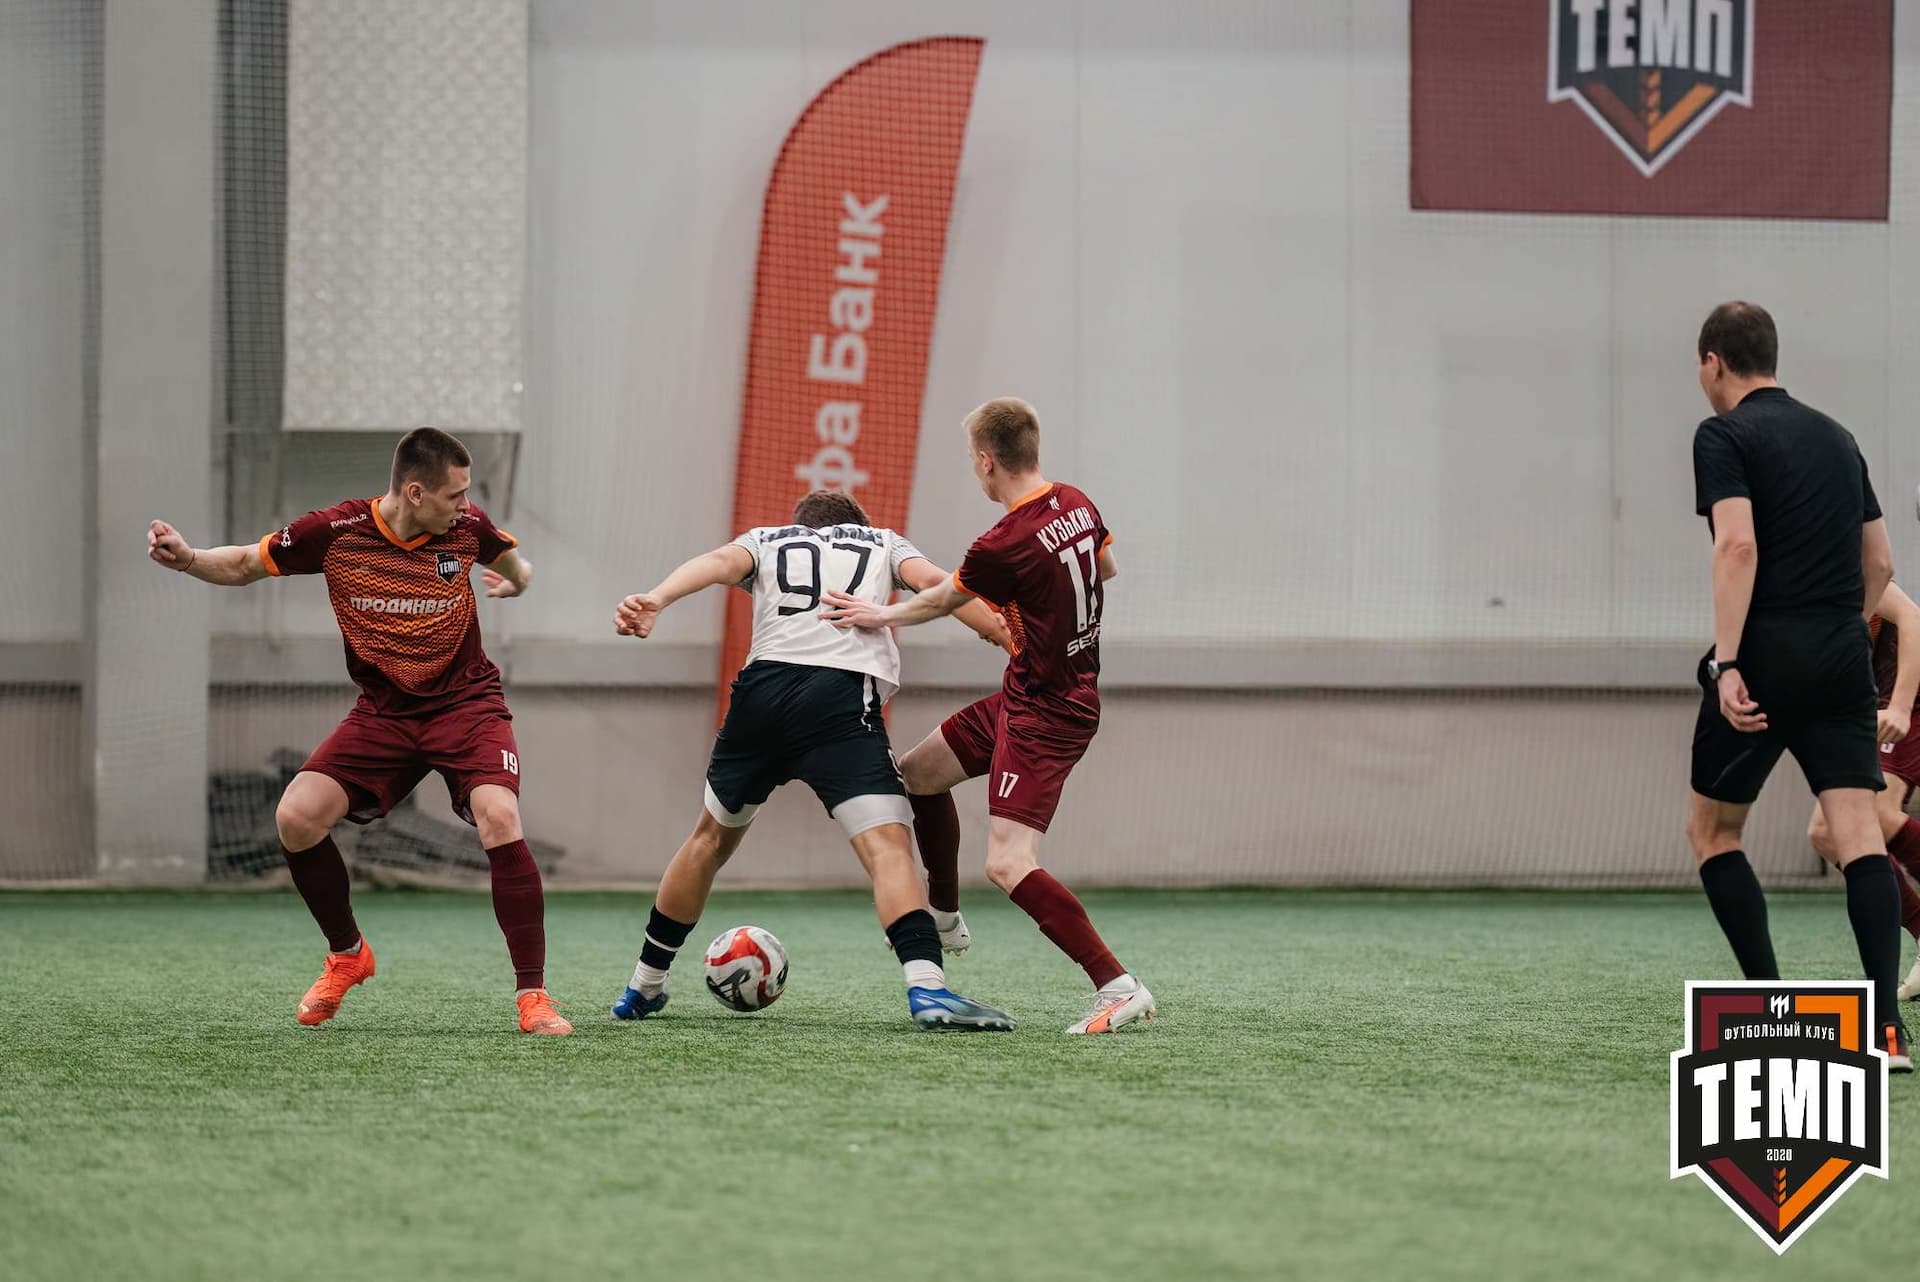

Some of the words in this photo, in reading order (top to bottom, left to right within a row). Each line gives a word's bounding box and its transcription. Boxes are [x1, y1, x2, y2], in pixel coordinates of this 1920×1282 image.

[1571, 0, 1734, 78] ТЕМП
[806, 192, 890, 384] Банк
[1036, 507, 1095, 553] КУЗЬКИН
[439, 560, 460, 575] ТЕМП
[776, 541, 873, 620] 97
[1058, 535, 1099, 634] 17
[500, 749, 519, 776] 19
[998, 771, 1020, 799] 17
